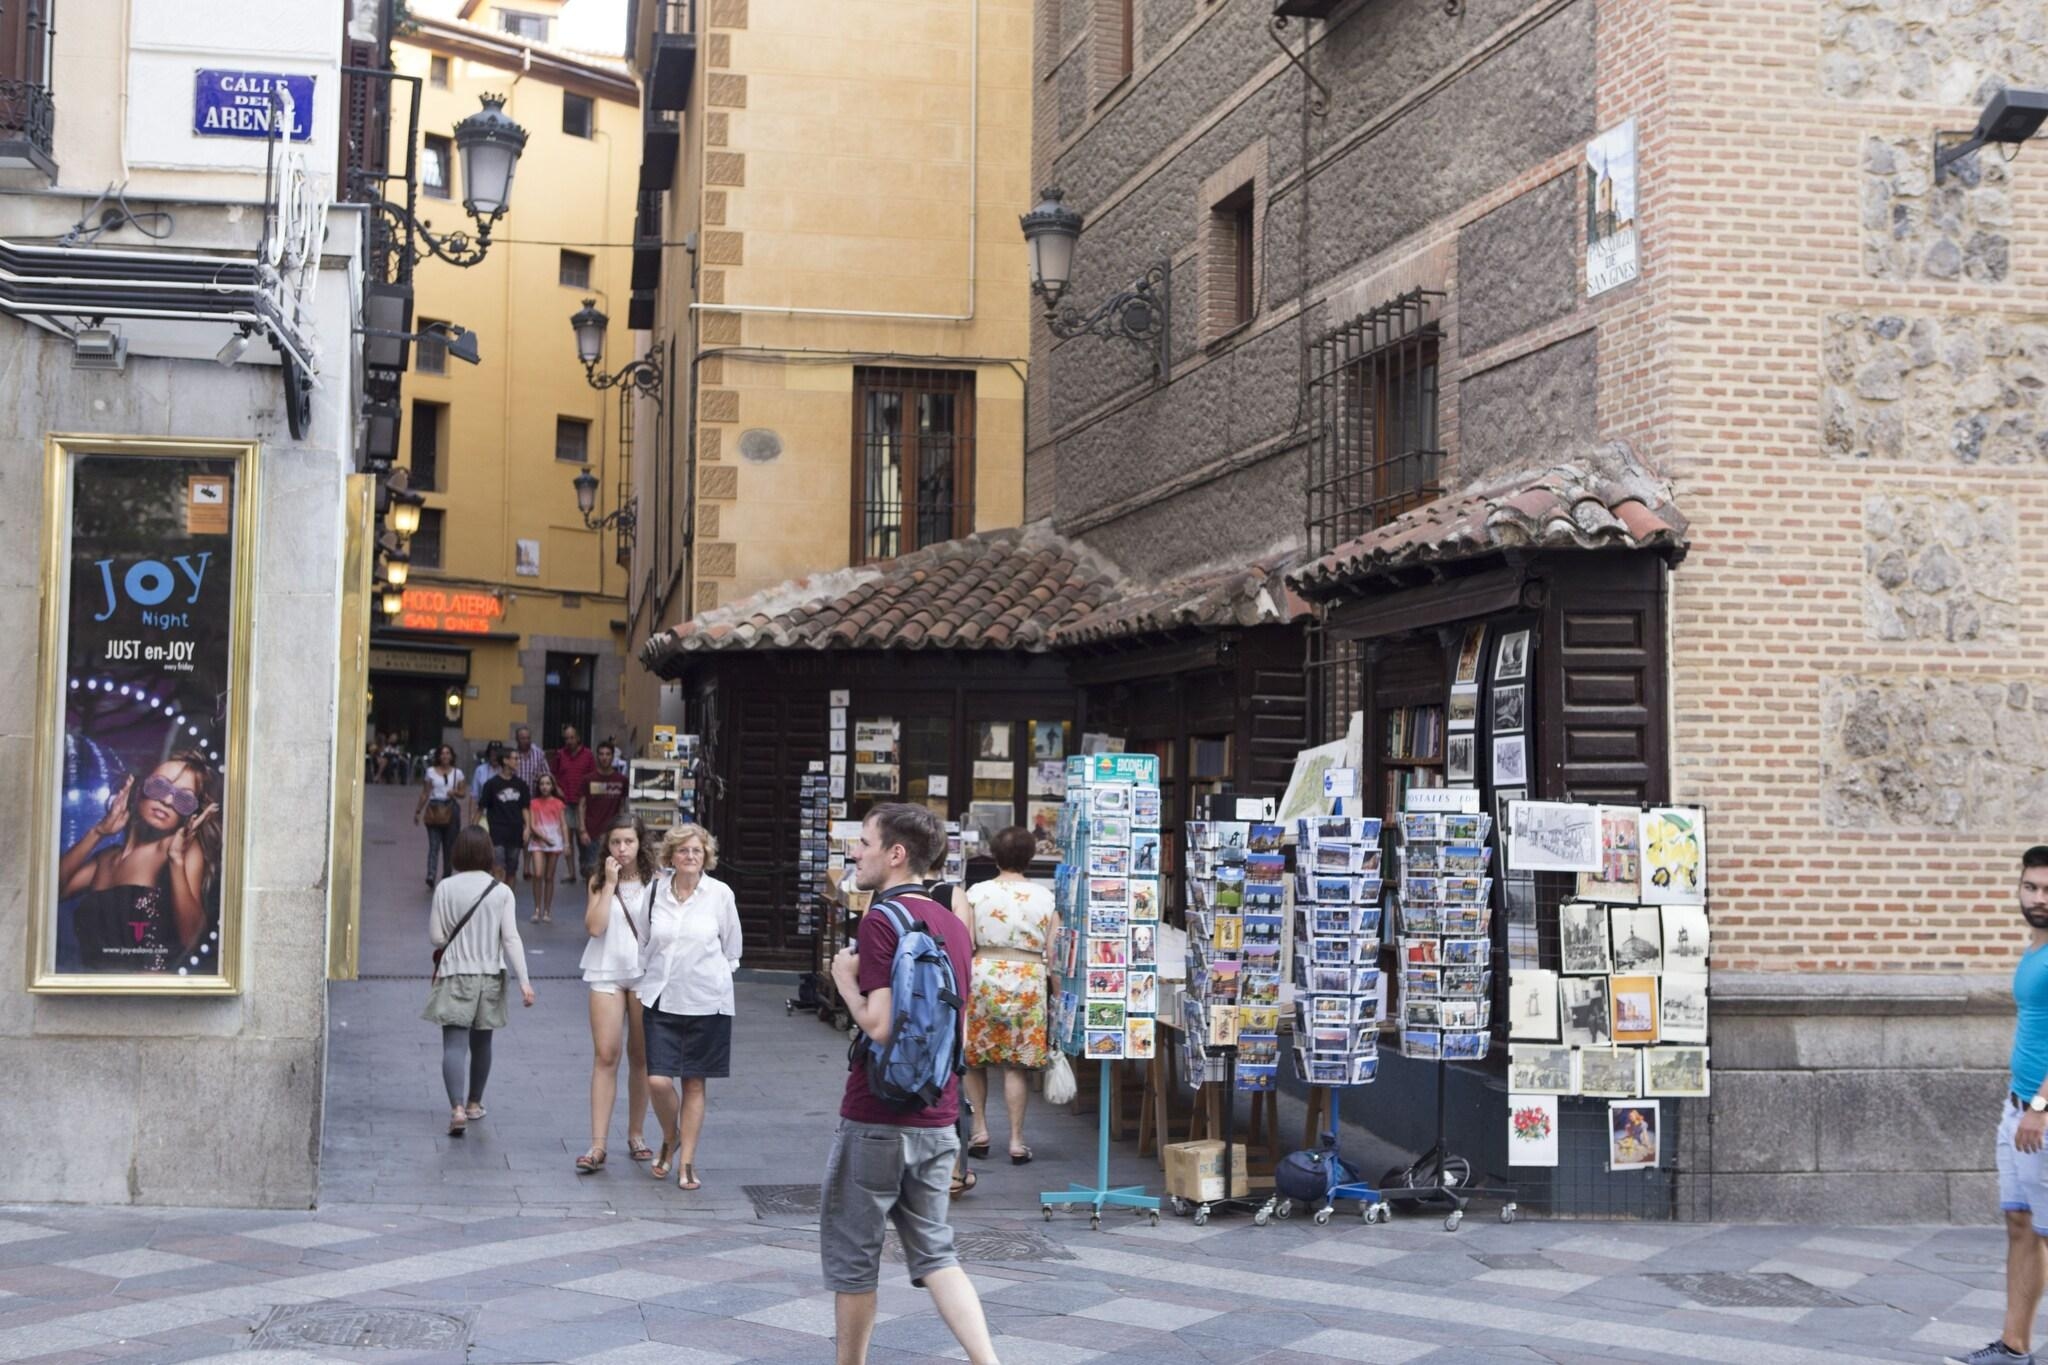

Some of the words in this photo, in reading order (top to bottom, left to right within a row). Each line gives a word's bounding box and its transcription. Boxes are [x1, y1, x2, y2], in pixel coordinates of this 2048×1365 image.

[235, 95, 272, 107] DEL
[203, 106, 302, 133] ARENAL
[402, 589, 499, 617] HOCOLATERIA
[142, 610, 190, 630] Night
[105, 640, 141, 659] JUST
[144, 641, 195, 660] en-JOY
